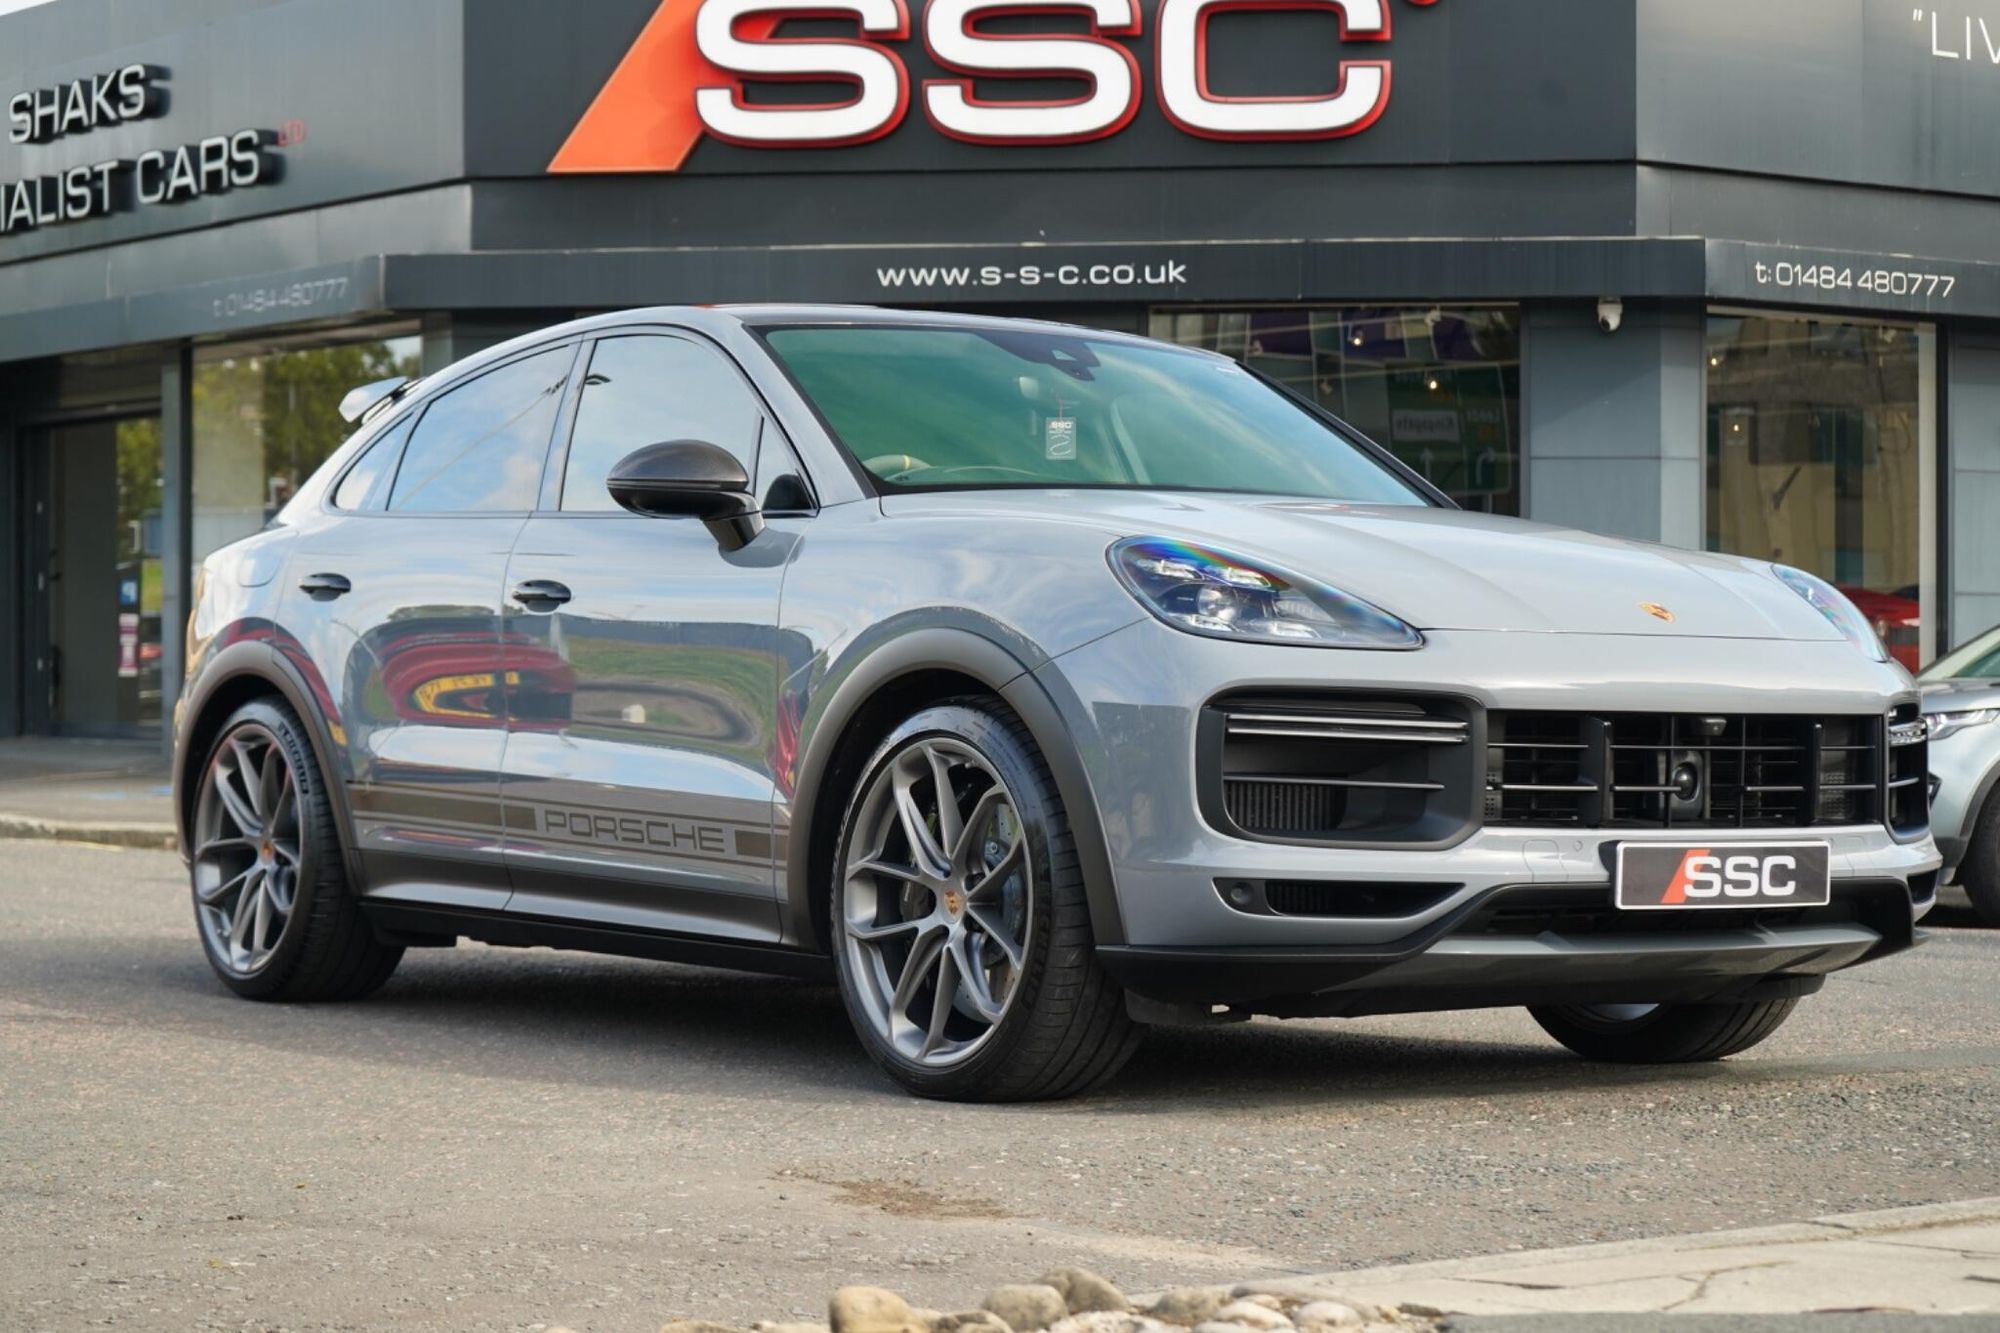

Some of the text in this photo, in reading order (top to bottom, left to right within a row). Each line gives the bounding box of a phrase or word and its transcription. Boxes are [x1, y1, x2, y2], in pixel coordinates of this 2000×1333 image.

[695, 0, 1391, 148] SSC
[8, 63, 148, 144] SHAKS
[136, 129, 261, 204] CARS
[876, 259, 1187, 287] www.s-s-c.co.uk
[1856, 269, 1956, 298] 480777
[543, 808, 726, 854] PORSCHE
[1683, 855, 1797, 898] SSC
